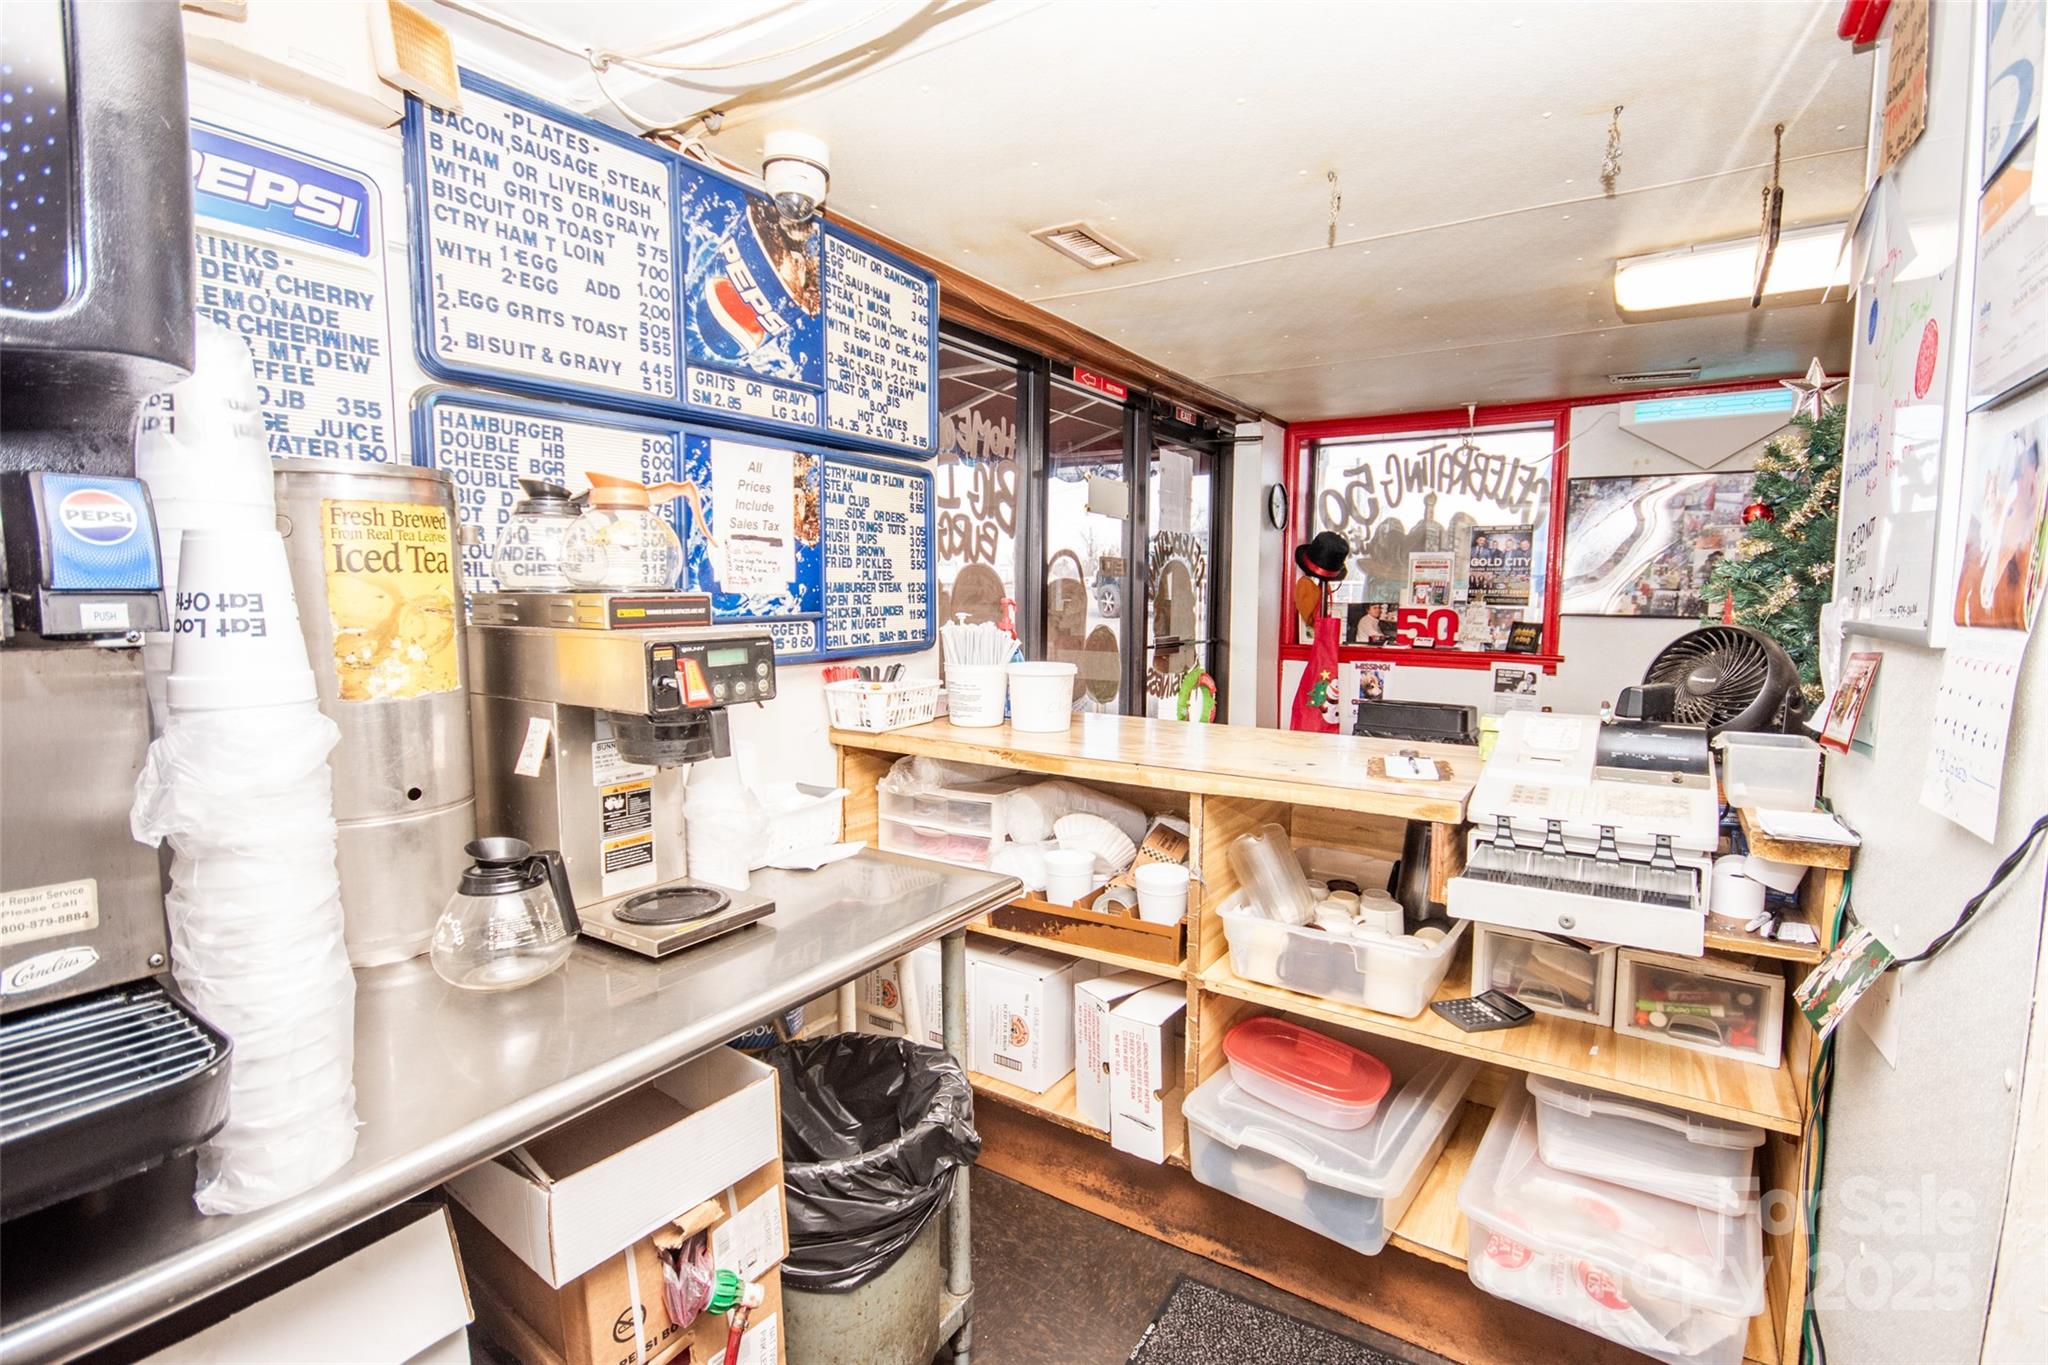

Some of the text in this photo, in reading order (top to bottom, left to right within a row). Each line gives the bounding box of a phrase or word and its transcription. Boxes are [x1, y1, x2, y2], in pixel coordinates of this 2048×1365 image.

[430, 131, 651, 221] B HAM OR LIVERMUSH
[432, 156, 659, 242] WITH GRITS OR GRAVY
[432, 180, 615, 248] BISCUIT OR TOAST
[434, 203, 489, 234] CTRY
[496, 221, 538, 251] HAM
[545, 236, 556, 252] T
[563, 241, 604, 266] LOIN
[436, 239, 491, 268] WITH
[825, 252, 844, 269] EGG
[829, 240, 866, 268] BISCUIT
[870, 261, 881, 275] OR
[276, 274, 374, 311] CHERRY
[586, 279, 621, 300] ADD
[507, 301, 565, 327] GRITS
[572, 316, 627, 341] TOAST
[827, 316, 850, 335] WITH
[854, 327, 871, 343] EGG
[890, 324, 908, 339] CHIC
[237, 314, 380, 356] CHEERWINE
[316, 350, 370, 374] DEW
[466, 332, 535, 360] BISUIT
[542, 348, 554, 364] &
[560, 351, 621, 376] GRAVY
[844, 342, 917, 376] SAMPLER PLATE
[696, 372, 807, 407] GRITS OR GRAVY
[827, 378, 900, 408] TOAST OR BIS
[840, 369, 914, 400] GRITS OR GRAVY
[337, 397, 382, 420] 355
[693, 389, 711, 405] SM
[772, 406, 787, 419] LG
[314, 419, 384, 443] JUICE
[439, 411, 564, 442] HAMBURGER
[858, 410, 908, 431] HOT CAKES
[440, 430, 519, 454] DOUBLE
[541, 443, 565, 459] HB
[440, 450, 518, 471] CHEESE
[529, 460, 565, 476] BGR
[748, 461, 763, 473] All
[738, 479, 772, 494] Prices
[825, 479, 853, 493] STEAK
[871, 473, 880, 484] OR
[735, 499, 775, 513] Include
[825, 491, 870, 507] HAM CLUB
[65, 510, 132, 522] PEPSI
[330, 507, 446, 530] Fresh Brewed
[729, 517, 780, 531] Sales Tax
[825, 517, 849, 530] FRIES
[888, 524, 906, 535] TOTS
[331, 527, 362, 539] From
[367, 528, 393, 540] Real
[396, 530, 415, 541] Tea
[825, 531, 849, 543] HUSH
[857, 533, 877, 545] PUPS
[332, 542, 448, 573] Iced Tea
[825, 543, 850, 556] HASH
[857, 546, 885, 557] BROWN
[1471, 557, 1531, 566] GOLD CITY
[826, 557, 852, 568] FRIED
[856, 558, 892, 569] PICKLES
[826, 582, 876, 593] HAMBURGER
[879, 582, 902, 592] STEAK
[826, 595, 848, 606] OPEN
[853, 595, 872, 605] FACE
[866, 606, 903, 617] FLOUNDER
[94, 612, 116, 620] PUSH
[826, 618, 886, 631] CHIC NUGGET
[1397, 608, 1460, 647] 50
[9, 888, 84, 906] Repair Service
[1, 900, 78, 918] Please Call
[12, 954, 80, 987] Cornelius
